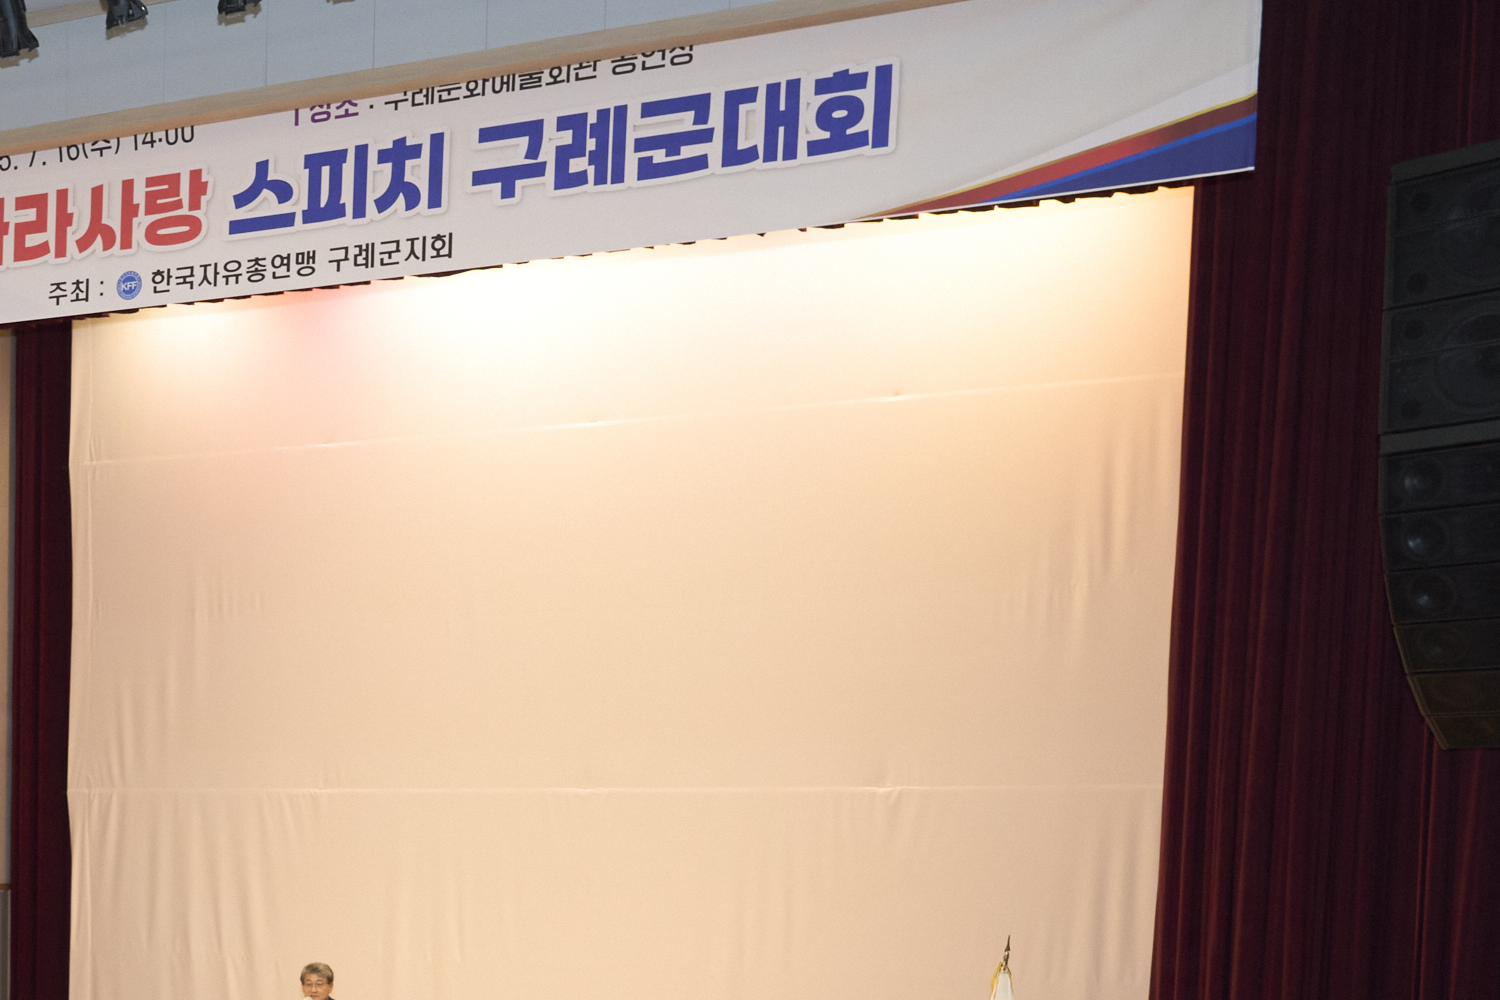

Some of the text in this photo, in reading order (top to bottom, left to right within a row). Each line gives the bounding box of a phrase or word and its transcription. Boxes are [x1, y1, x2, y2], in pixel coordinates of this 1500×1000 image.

[229, 132, 444, 235] 스피치
[472, 64, 893, 200] 구례군대회
[48, 278, 90, 306] 주최
[150, 249, 318, 295] 한국자유총연맹
[327, 232, 454, 273] 구례군지회
